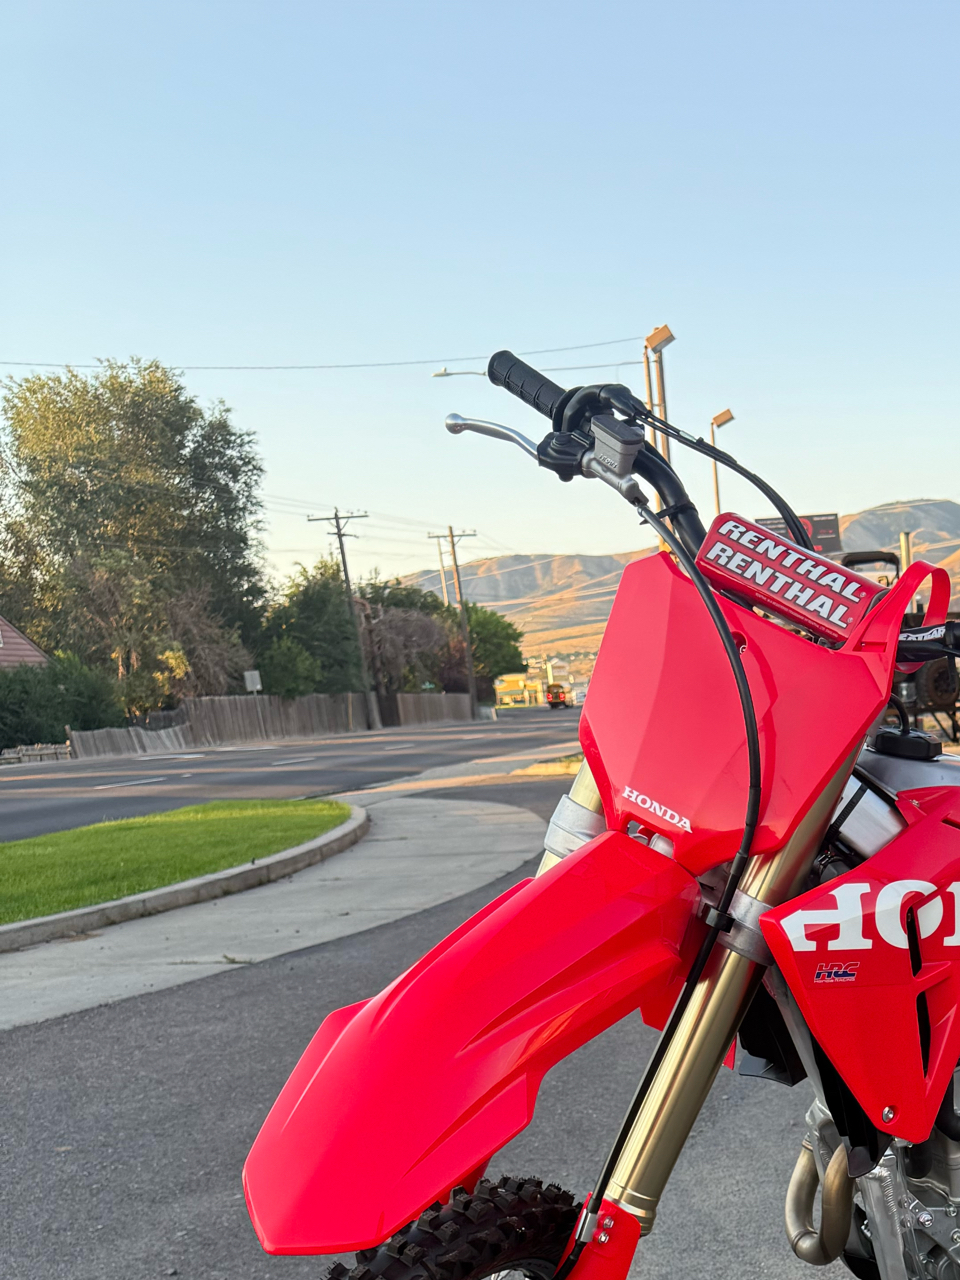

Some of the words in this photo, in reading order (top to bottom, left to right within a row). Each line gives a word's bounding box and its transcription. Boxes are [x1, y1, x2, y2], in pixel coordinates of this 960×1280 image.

[706, 541, 849, 629] RENTHAL
[718, 520, 861, 603] RENTHAL
[622, 785, 693, 834] HONDA
[814, 961, 861, 980] HRC
